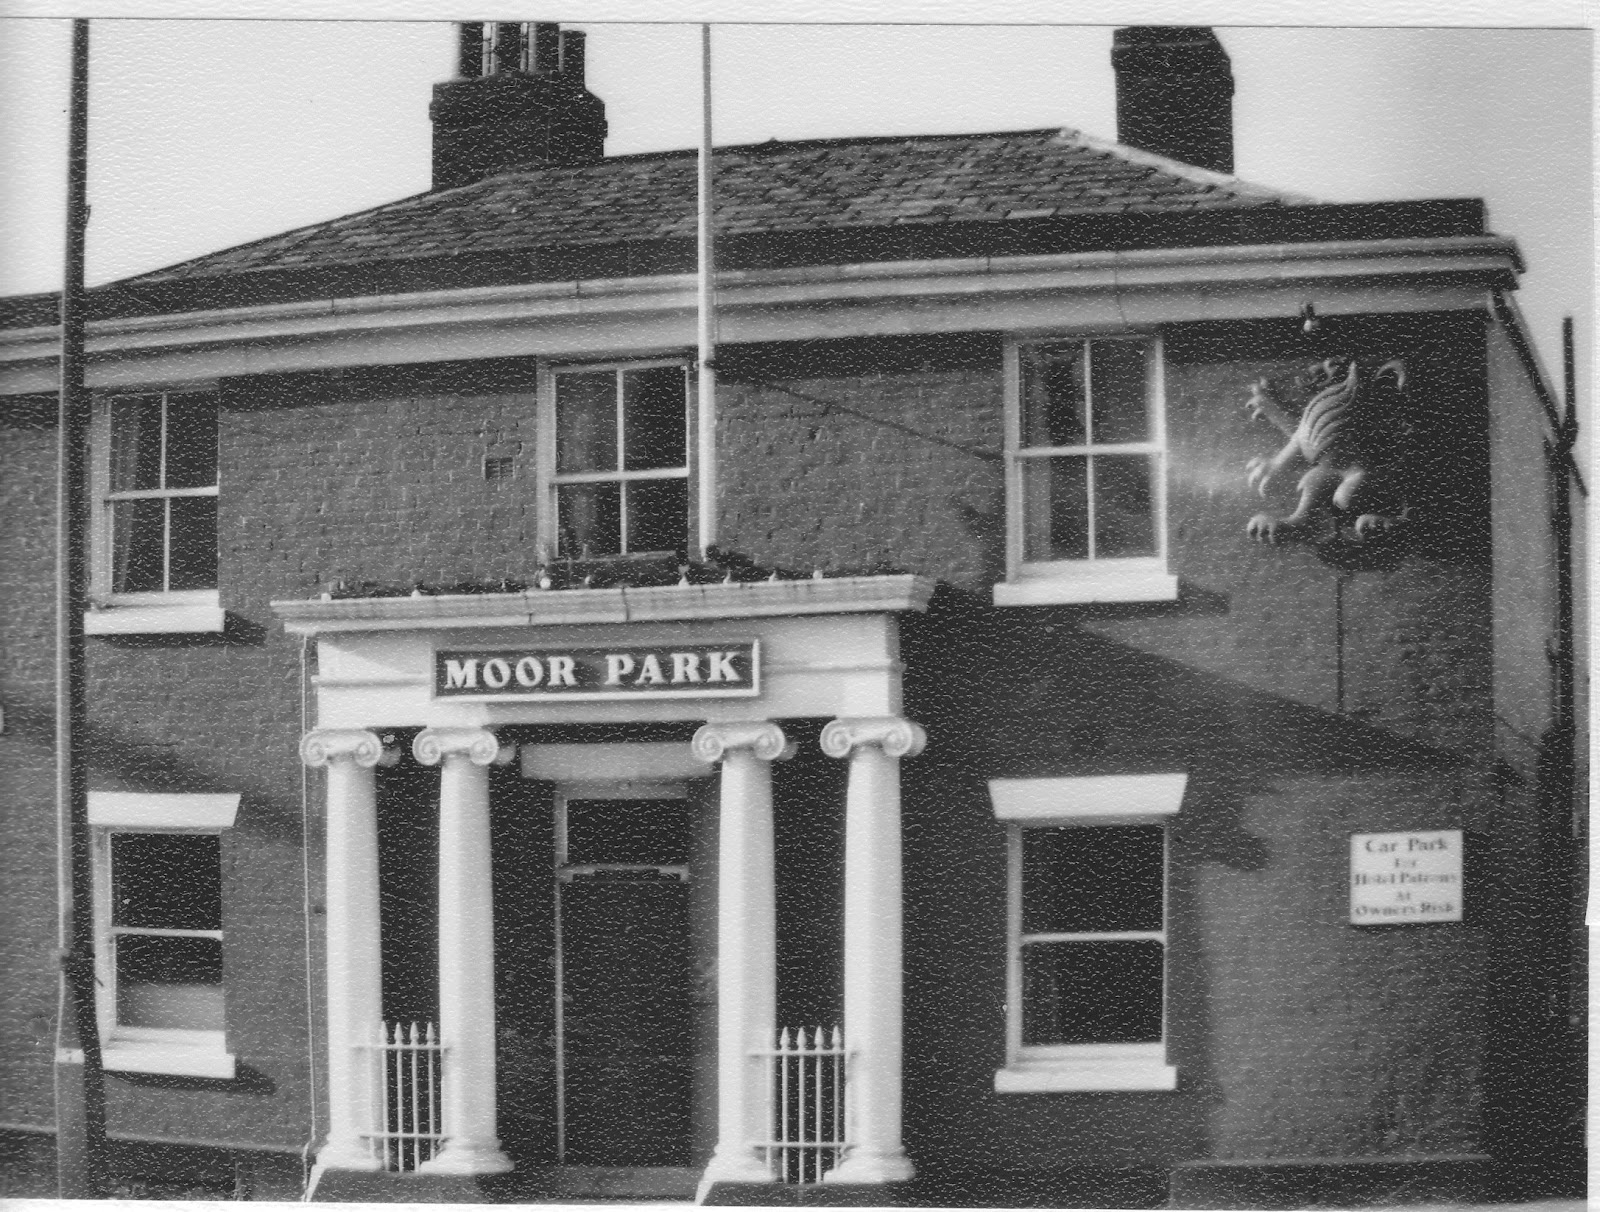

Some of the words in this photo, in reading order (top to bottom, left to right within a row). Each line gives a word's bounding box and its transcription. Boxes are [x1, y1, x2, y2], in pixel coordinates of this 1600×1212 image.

[444, 655, 577, 690] MOOR
[604, 650, 741, 686] PARK
[1365, 840, 1396, 853] Car
[1408, 838, 1448, 852] Park
